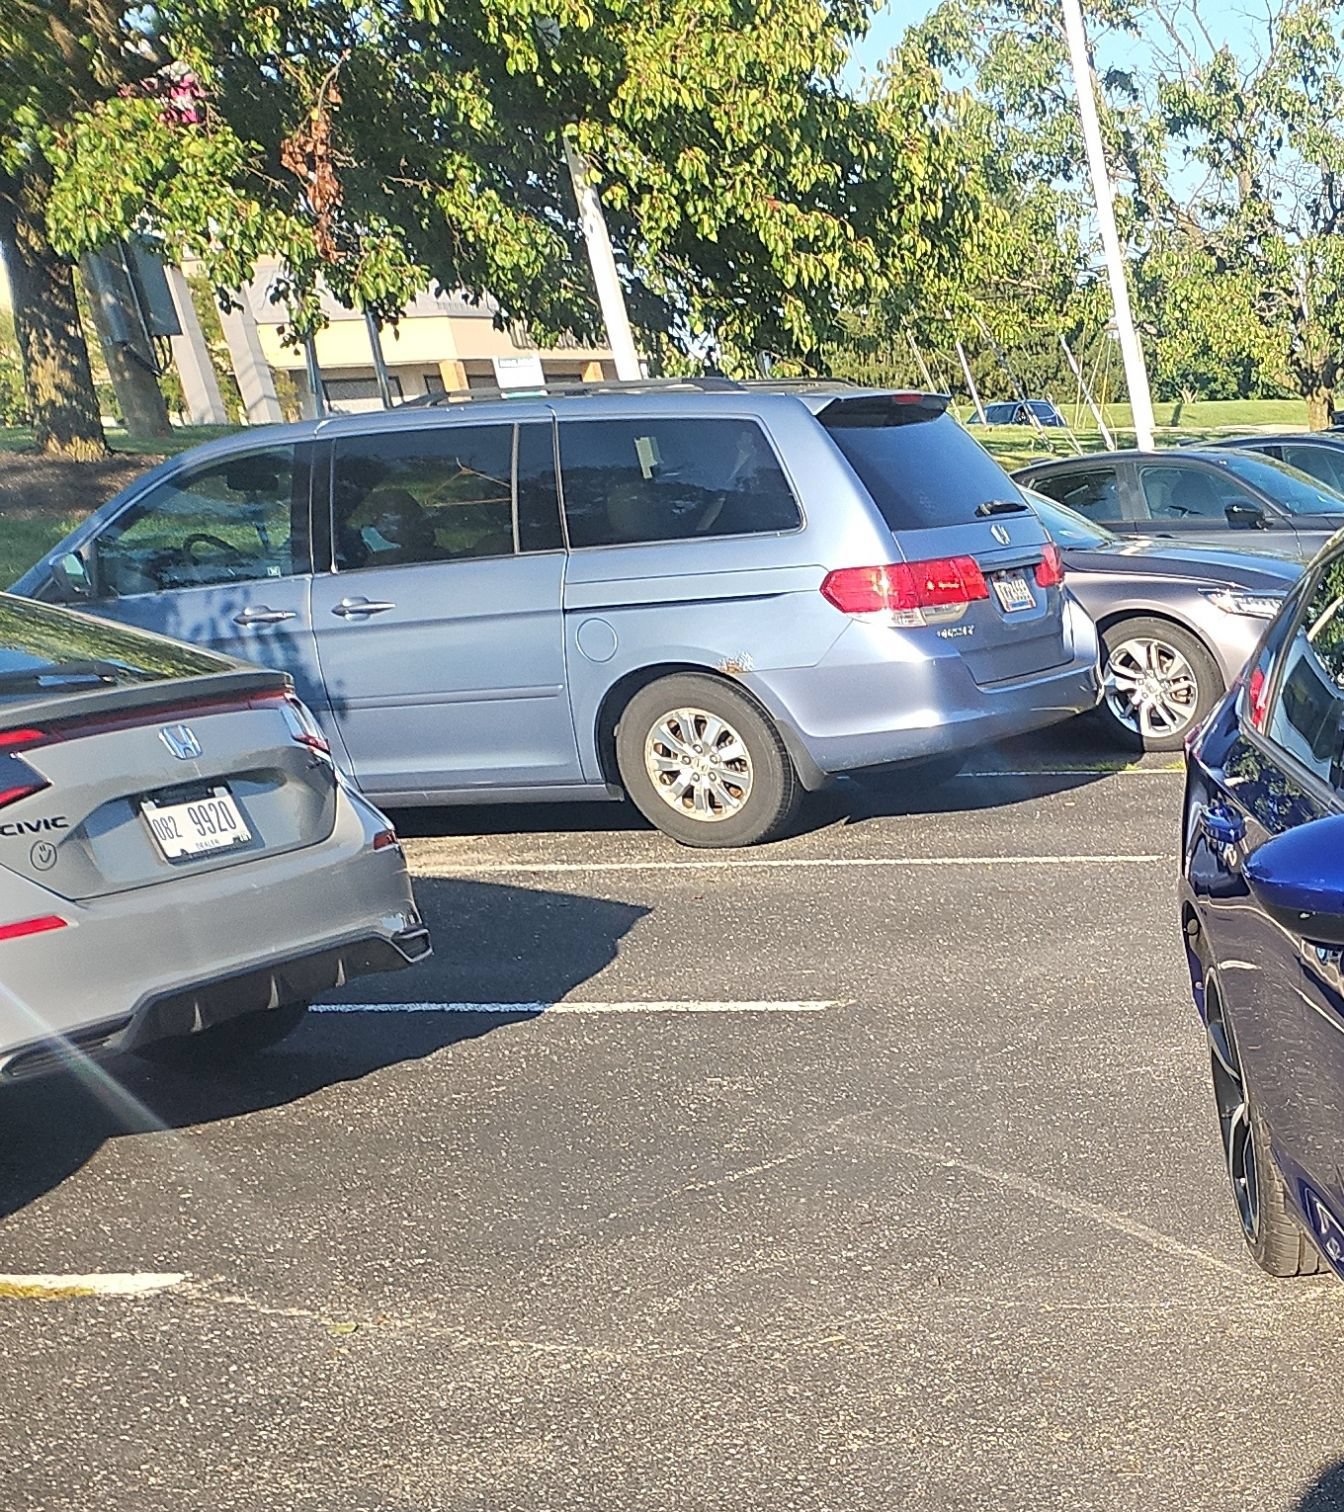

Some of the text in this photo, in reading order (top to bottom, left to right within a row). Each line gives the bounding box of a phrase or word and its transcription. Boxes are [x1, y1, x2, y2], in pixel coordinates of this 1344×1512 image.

[0, 815, 69, 837] CIVIC
[152, 800, 238, 841] 082 9920
